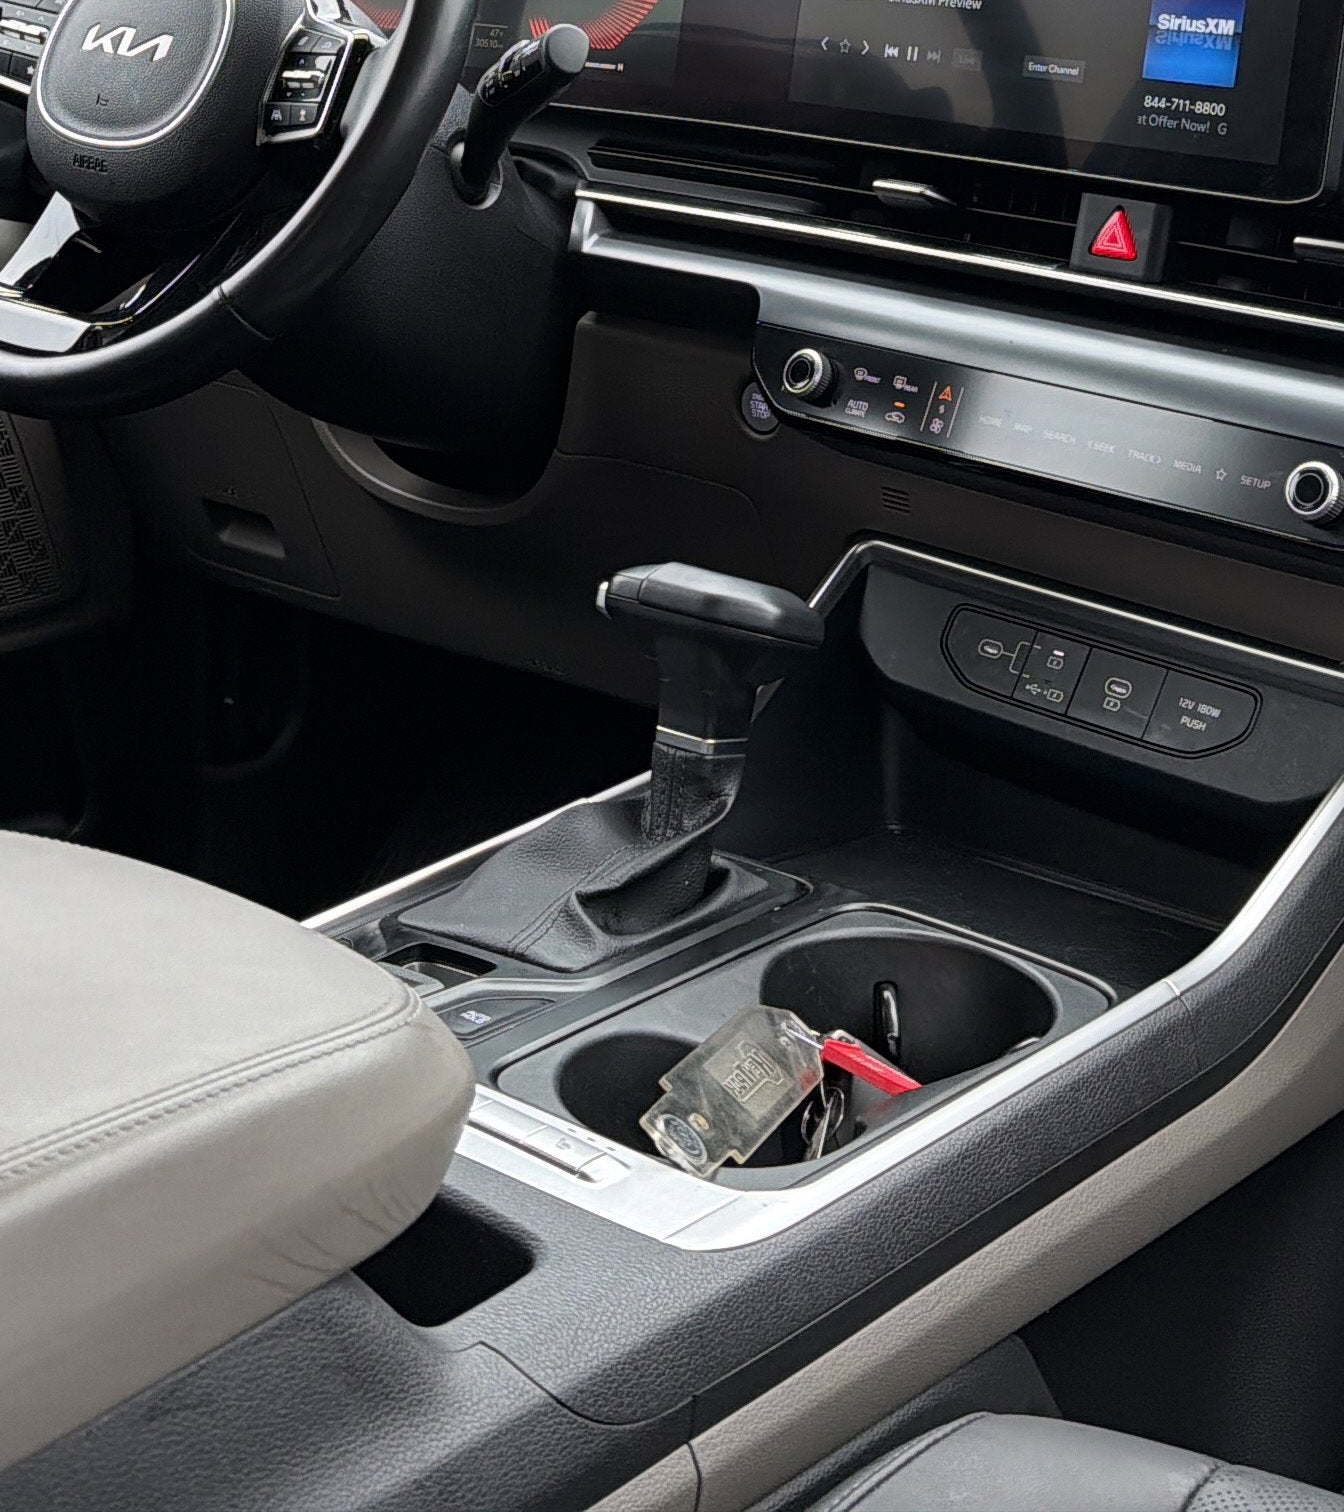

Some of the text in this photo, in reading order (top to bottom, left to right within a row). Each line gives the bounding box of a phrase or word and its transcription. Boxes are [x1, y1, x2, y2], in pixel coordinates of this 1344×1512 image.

[1157, 13, 1236, 36] SiriusXM
[1028, 61, 1080, 76] Enter Channel
[1143, 95, 1226, 117] 844-711-8800
[1148, 113, 1178, 129] Offer
[1180, 117, 1210, 133] Now!
[1217, 123, 1228, 135] G
[847, 399, 869, 411] AUTO
[978, 414, 1002, 428] HOME
[1042, 429, 1077, 445] SEARCH
[1094, 441, 1115, 454] SEEK
[1128, 448, 1155, 464] TRACK
[1172, 459, 1203, 475] MEDIA
[1239, 475, 1272, 490] SETUP
[1178, 697, 1222, 719] 12V 180W
[1179, 715, 1207, 732] PUSH
